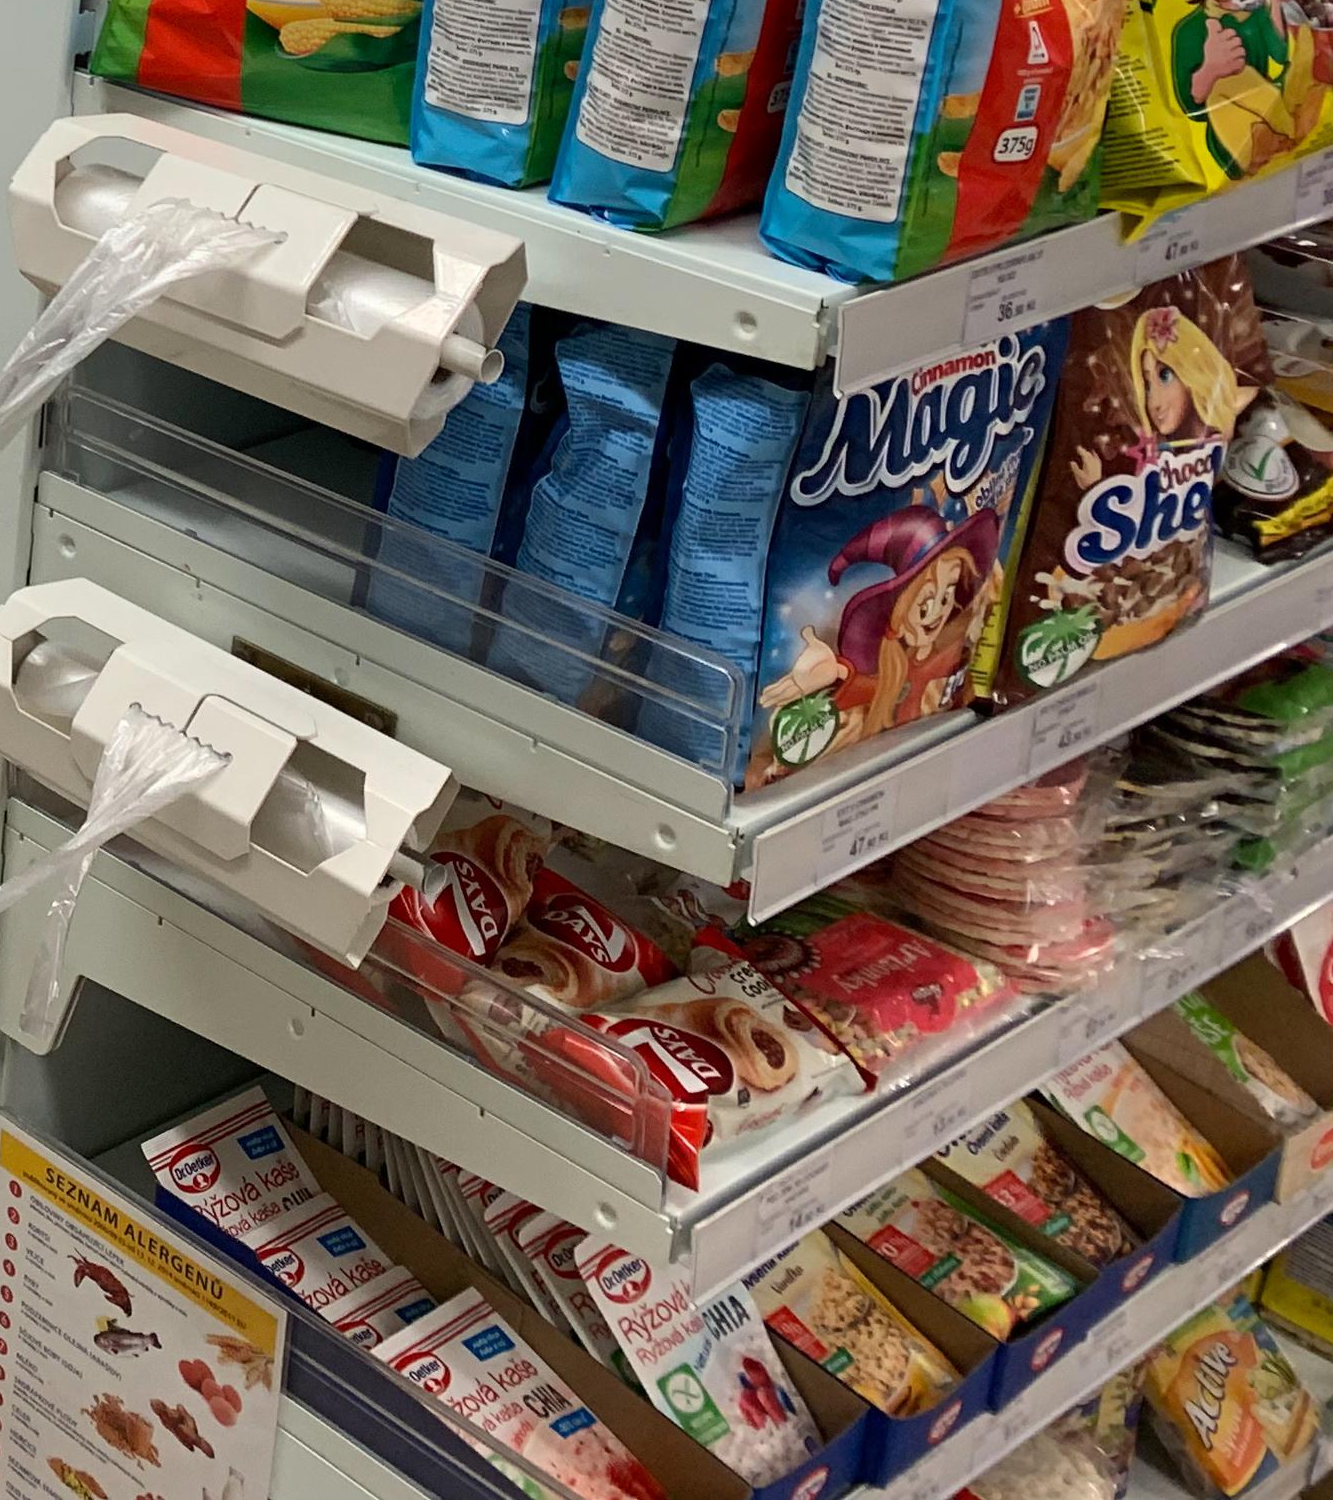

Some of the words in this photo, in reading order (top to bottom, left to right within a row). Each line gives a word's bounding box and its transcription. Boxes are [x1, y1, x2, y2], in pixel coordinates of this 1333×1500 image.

[996, 134, 1034, 160] 375g
[911, 349, 996, 397] Cinnamon
[794, 336, 1046, 504] Magic
[1077, 455, 1219, 566] She
[1028, 658, 1047, 673] NO
[1047, 641, 1079, 665] PALM
[1079, 629, 1098, 646] OIL
[794, 724, 818, 745] PALM
[817, 713, 833, 731] OIL
[173, 1152, 216, 1180] Dr.Oetker
[262, 1161, 300, 1189] kaše
[45, 1167, 120, 1228] SEZNAM
[124, 1224, 224, 1300] ALERGENŮ
[253, 1200, 280, 1226] kaša
[345, 1256, 386, 1283] kaše
[601, 1258, 643, 1292] Dr.Oetker
[617, 1289, 687, 1345] Rýžová
[703, 1294, 751, 1342] CHIA
[493, 1358, 540, 1393] kaše
[1184, 1337, 1238, 1449] Active
[498, 1401, 525, 1425] kaša
[524, 1382, 572, 1419] CHIA
